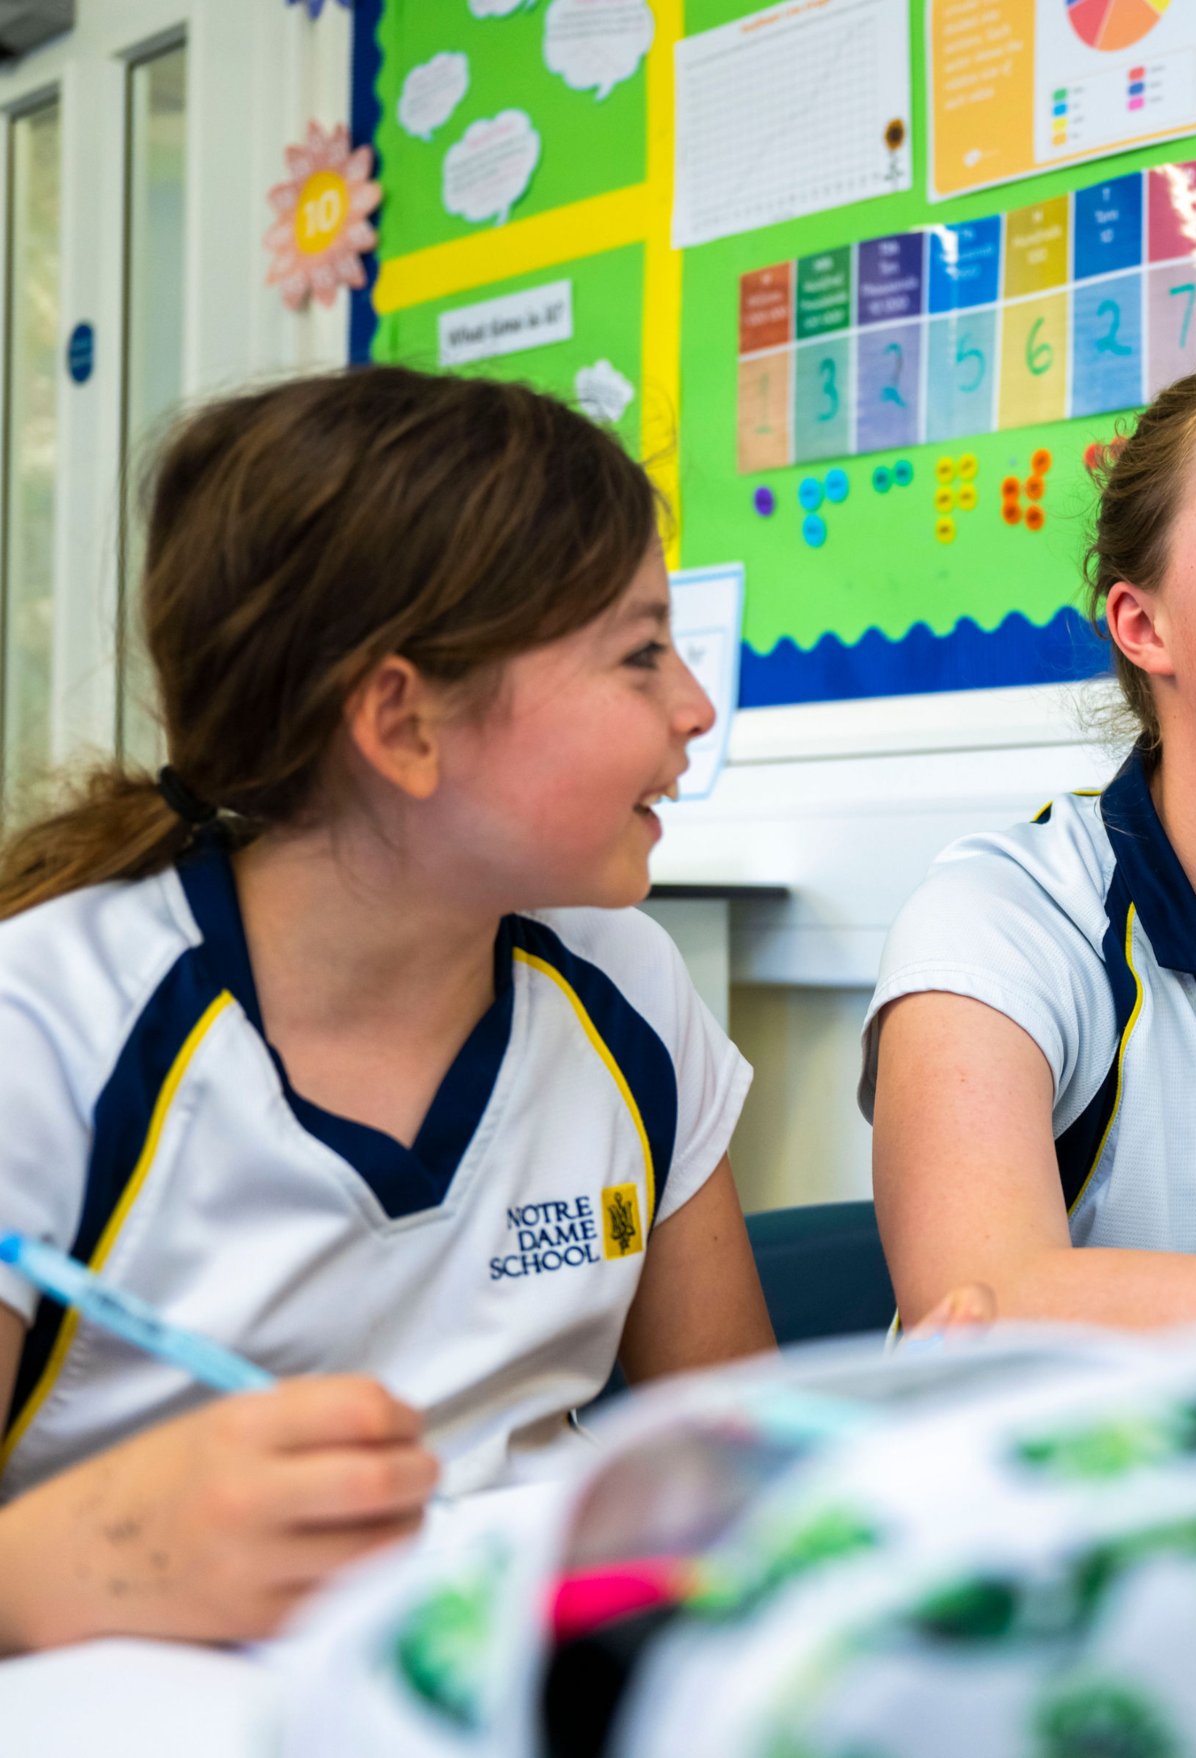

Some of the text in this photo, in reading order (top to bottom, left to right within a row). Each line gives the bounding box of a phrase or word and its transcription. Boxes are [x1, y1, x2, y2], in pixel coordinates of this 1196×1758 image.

[303, 187, 341, 238] 10
[816, 356, 841, 424] 3
[955, 330, 987, 395] 5
[1025, 316, 1054, 376] 6
[1096, 300, 1133, 356] 2
[1169, 282, 1196, 349] 7
[506, 1195, 594, 1230] NOTRE
[518, 1219, 597, 1252] DAME
[489, 1243, 600, 1281] SCHOOL
